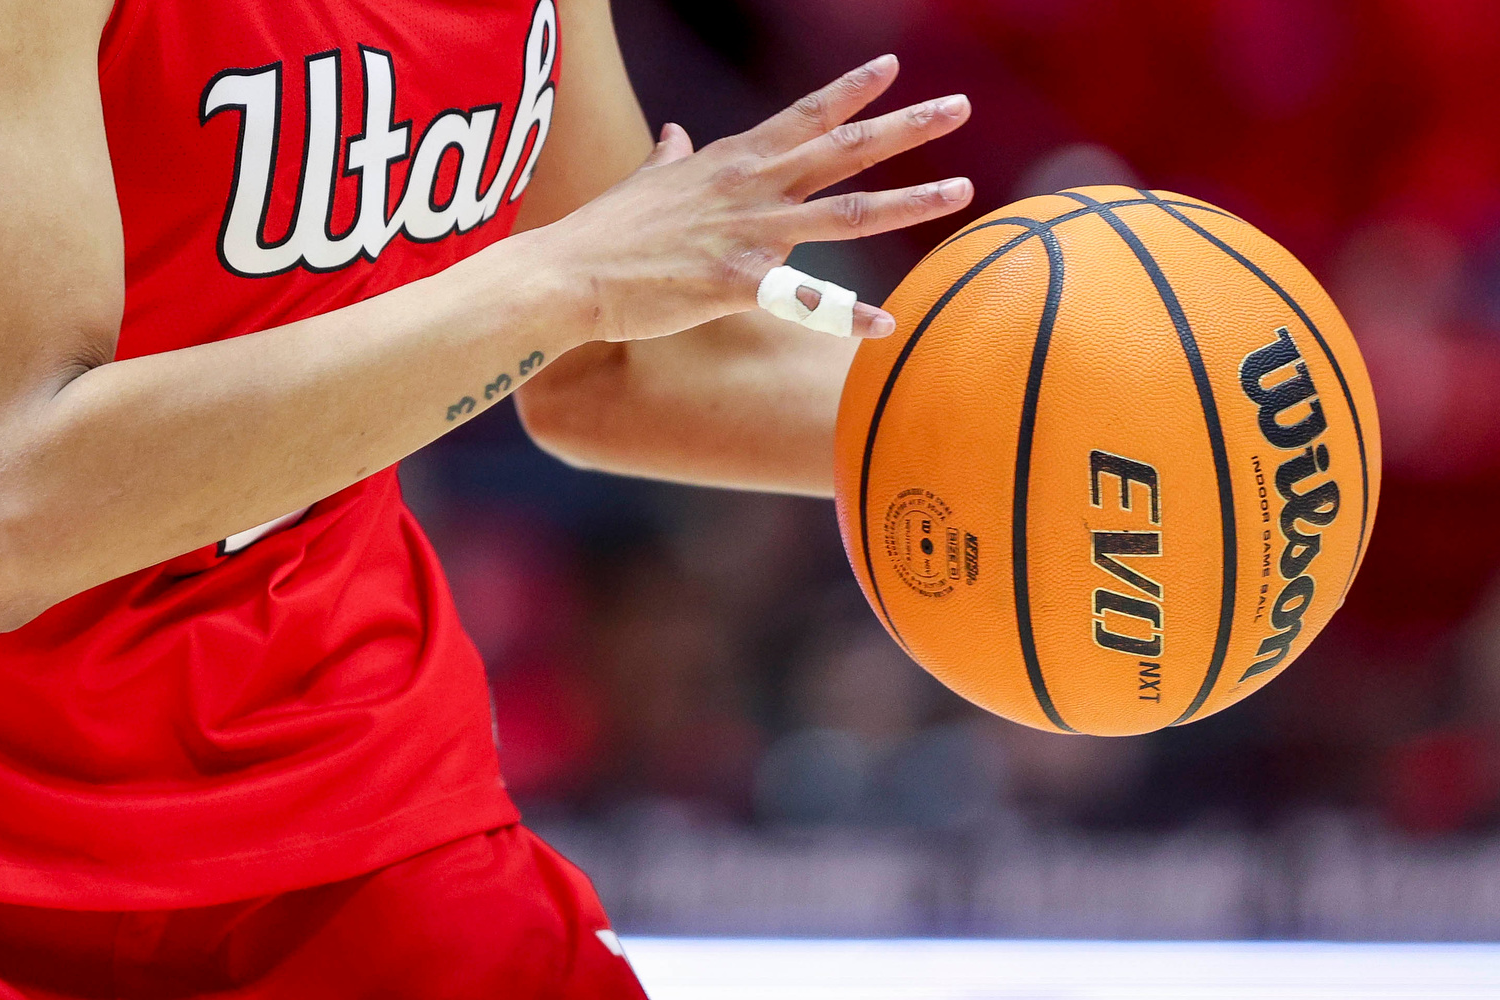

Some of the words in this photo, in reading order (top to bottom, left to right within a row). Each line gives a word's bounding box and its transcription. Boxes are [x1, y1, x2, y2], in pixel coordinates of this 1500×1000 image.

[1237, 325, 1341, 684] Wilson
[1251, 455, 1271, 524] INDOOR
[1088, 449, 1164, 657] EVO
[1261, 529, 1272, 578] GAME
[1253, 583, 1271, 624] BALL
[1138, 660, 1162, 703] NXT
